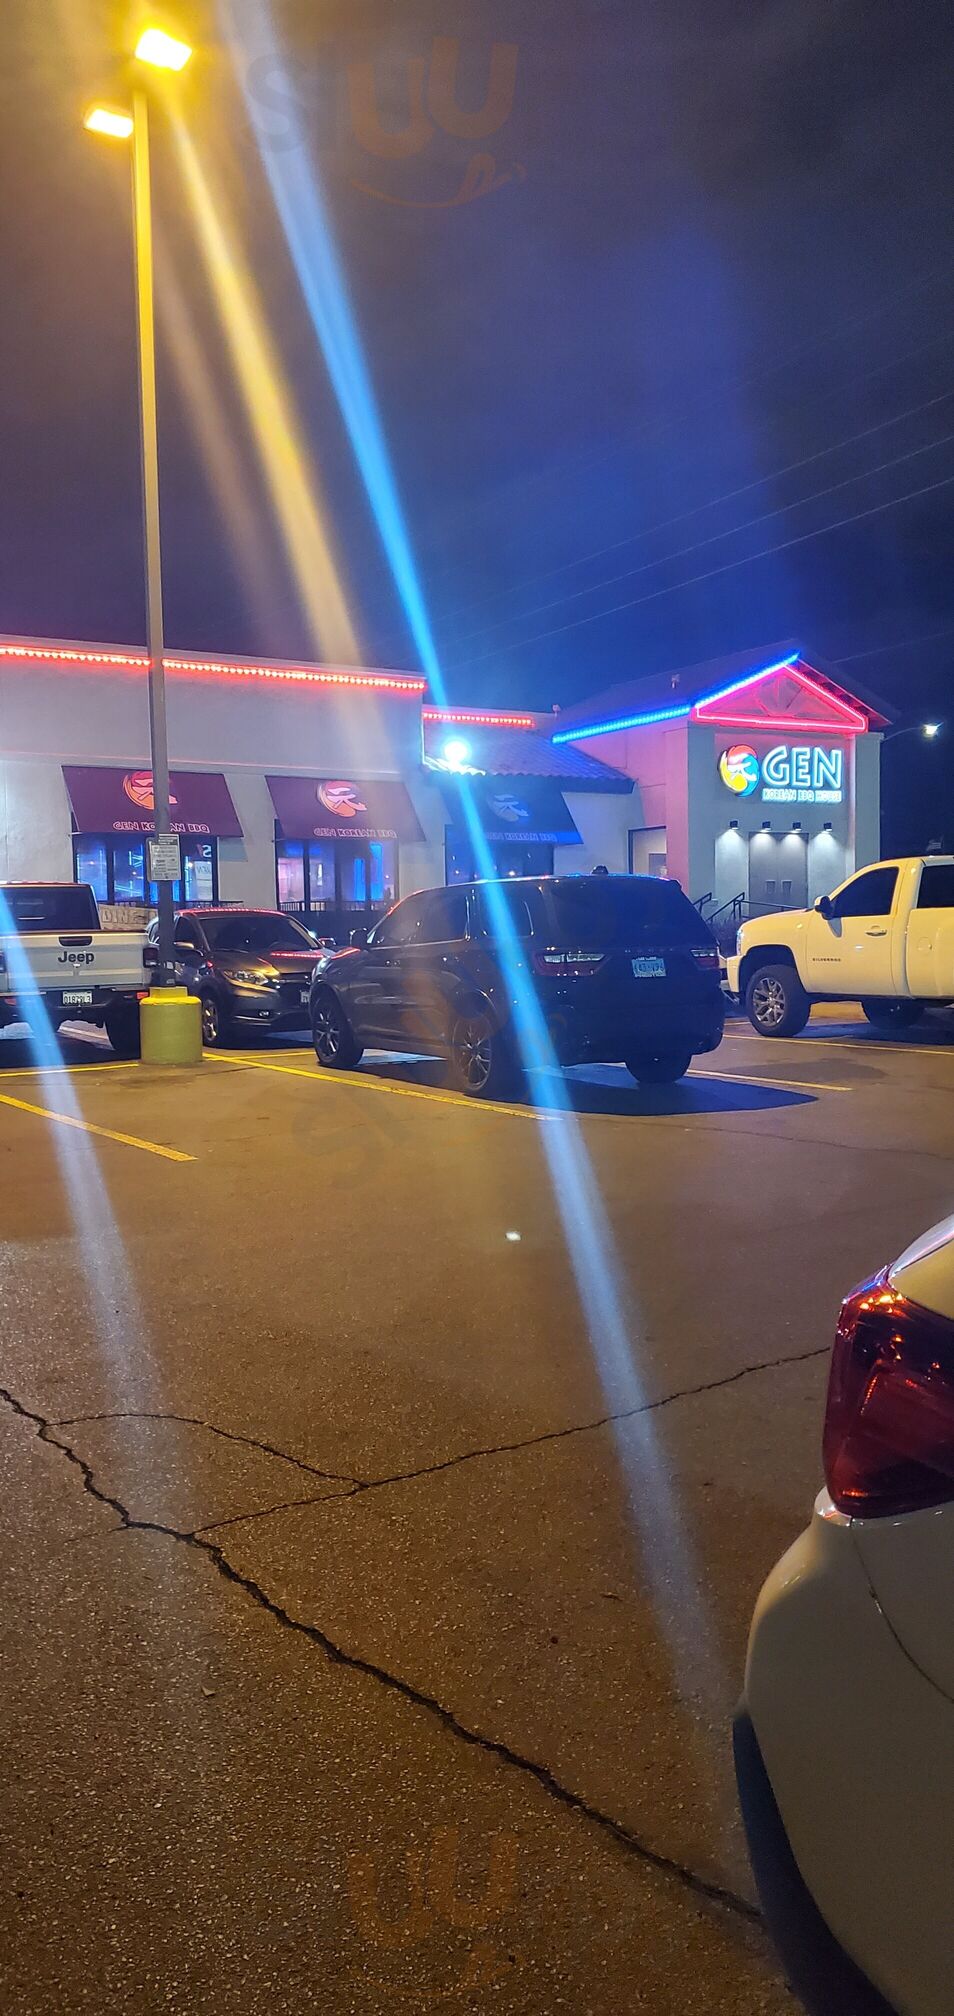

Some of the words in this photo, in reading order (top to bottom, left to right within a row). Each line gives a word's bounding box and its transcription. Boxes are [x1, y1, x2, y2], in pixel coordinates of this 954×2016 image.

[761, 745, 842, 789] GEN
[762, 788, 797, 802] KOREAN
[798, 789, 815, 802] BBQ
[113, 821, 139, 831] GEN
[141, 822, 186, 833] KOAN
[187, 823, 210, 834] BBQ
[313, 826, 336, 837] GEN
[337, 828, 377, 838] KOREAN
[58, 951, 94, 965] Jeep
